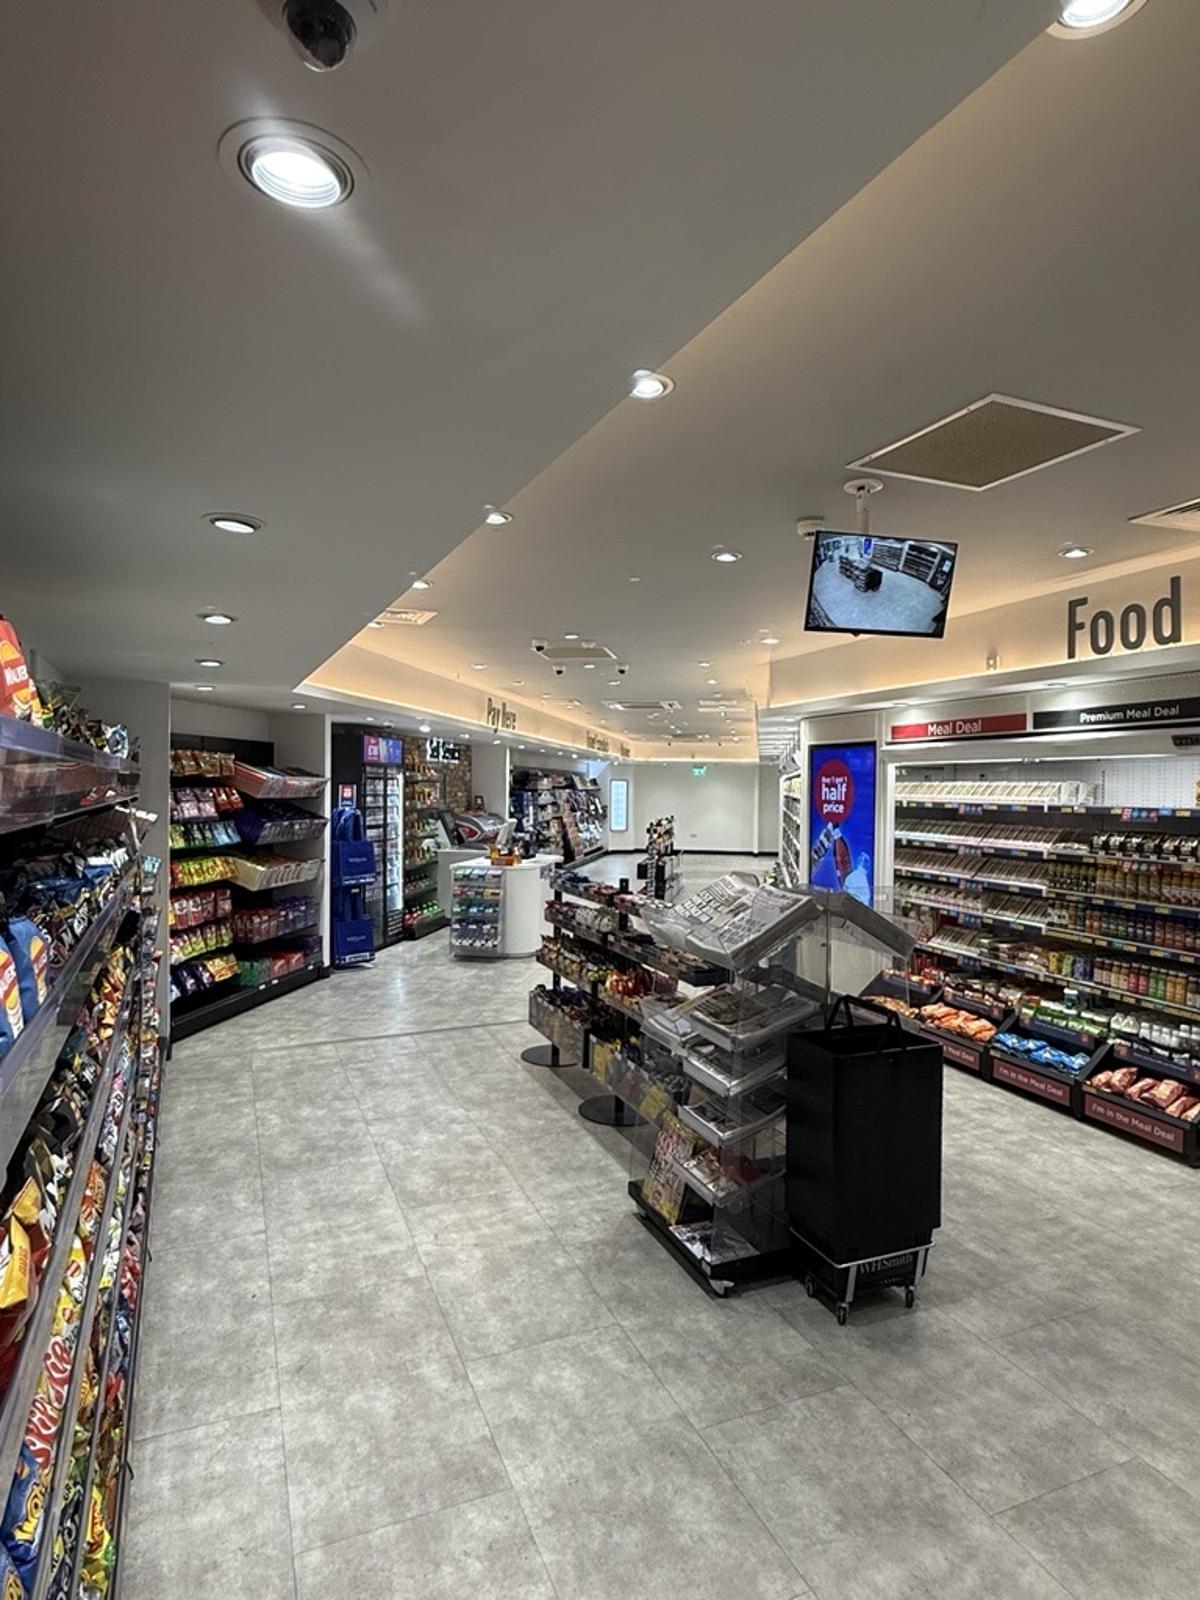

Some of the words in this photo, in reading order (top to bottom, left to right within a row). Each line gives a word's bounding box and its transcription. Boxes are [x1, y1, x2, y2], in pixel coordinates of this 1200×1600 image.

[1067, 575, 1182, 660] Food
[487, 697, 500, 733] Pay
[1080, 711, 1124, 723] Premium
[1126, 706, 1151, 719] Meal
[1154, 704, 1179, 717] Deal
[927, 722, 952, 736] Meal
[956, 719, 982, 734] Deal
[821, 783, 847, 801] half
[823, 801, 845, 815] price
[1029, 1077, 1046, 1090] Meal
[1046, 1083, 1063, 1097] Deal
[1091, 1103, 1105, 1114] I'm
[1106, 1107, 1115, 1118] in
[1115, 1112, 1130, 1124] the
[1131, 1118, 1153, 1133] Meal
[1153, 1126, 1175, 1141] Deal
